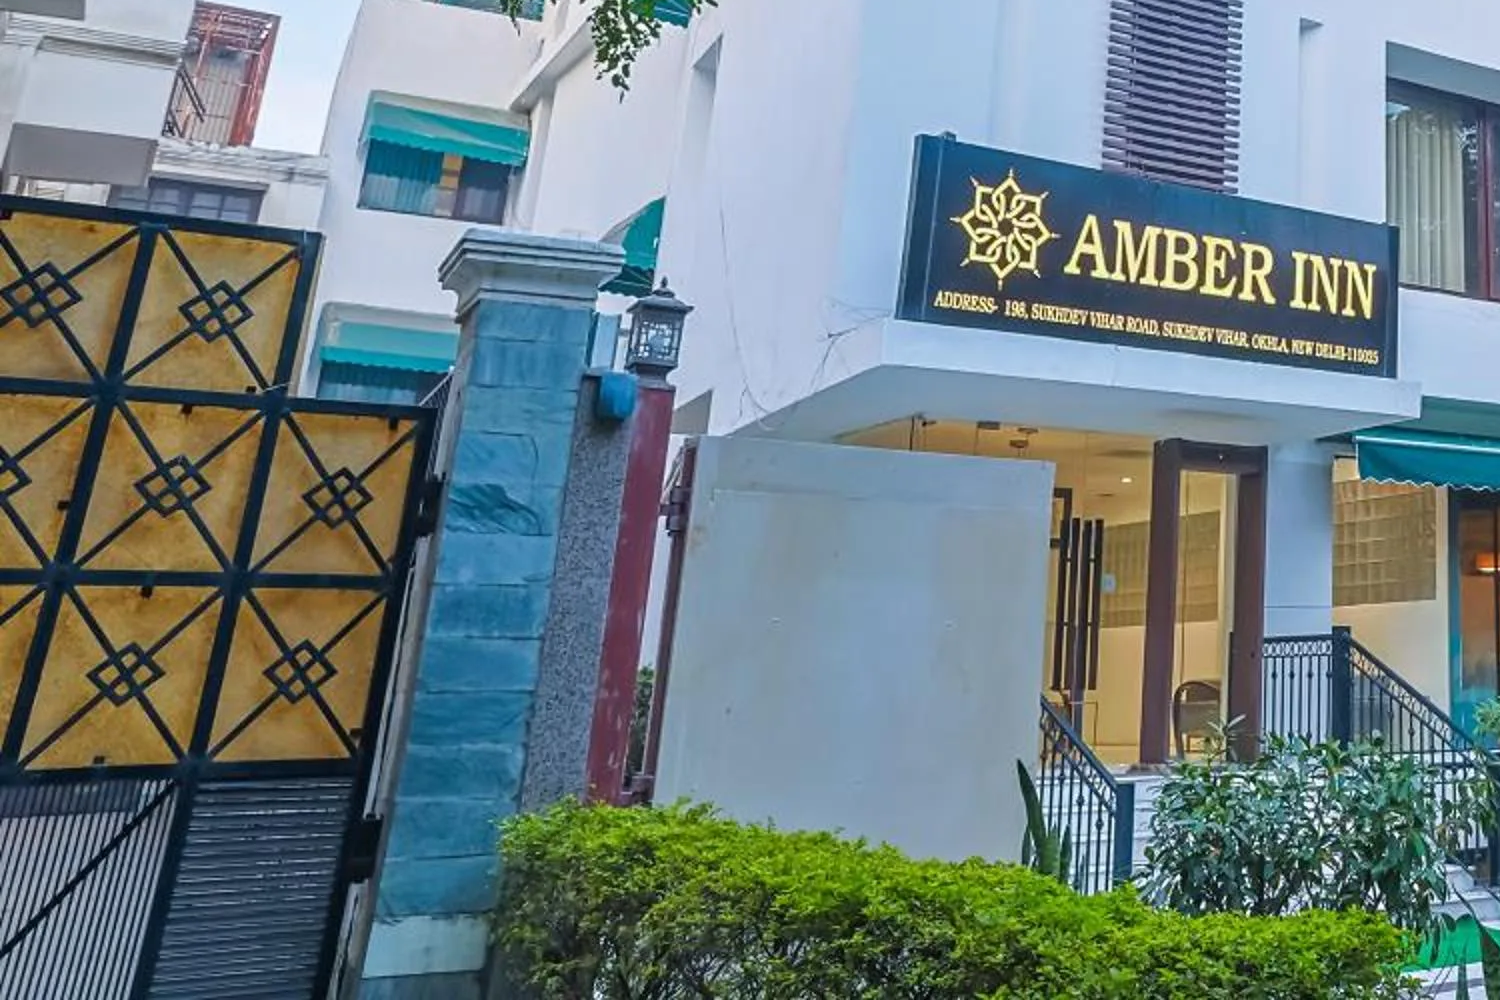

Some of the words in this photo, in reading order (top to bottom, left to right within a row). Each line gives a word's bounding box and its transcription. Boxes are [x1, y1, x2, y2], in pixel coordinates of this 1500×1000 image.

[1063, 213, 1276, 305] AMBER
[1289, 250, 1377, 320] INN
[934, 290, 998, 314] ADDRESS-
[1031, 303, 1088, 326] SUKHDEV
[1090, 310, 1124, 331] VIHAR
[1125, 315, 1160, 337] ROAD,
[1162, 321, 1215, 343] SUKHDEV
[1291, 338, 1314, 356] NEW
